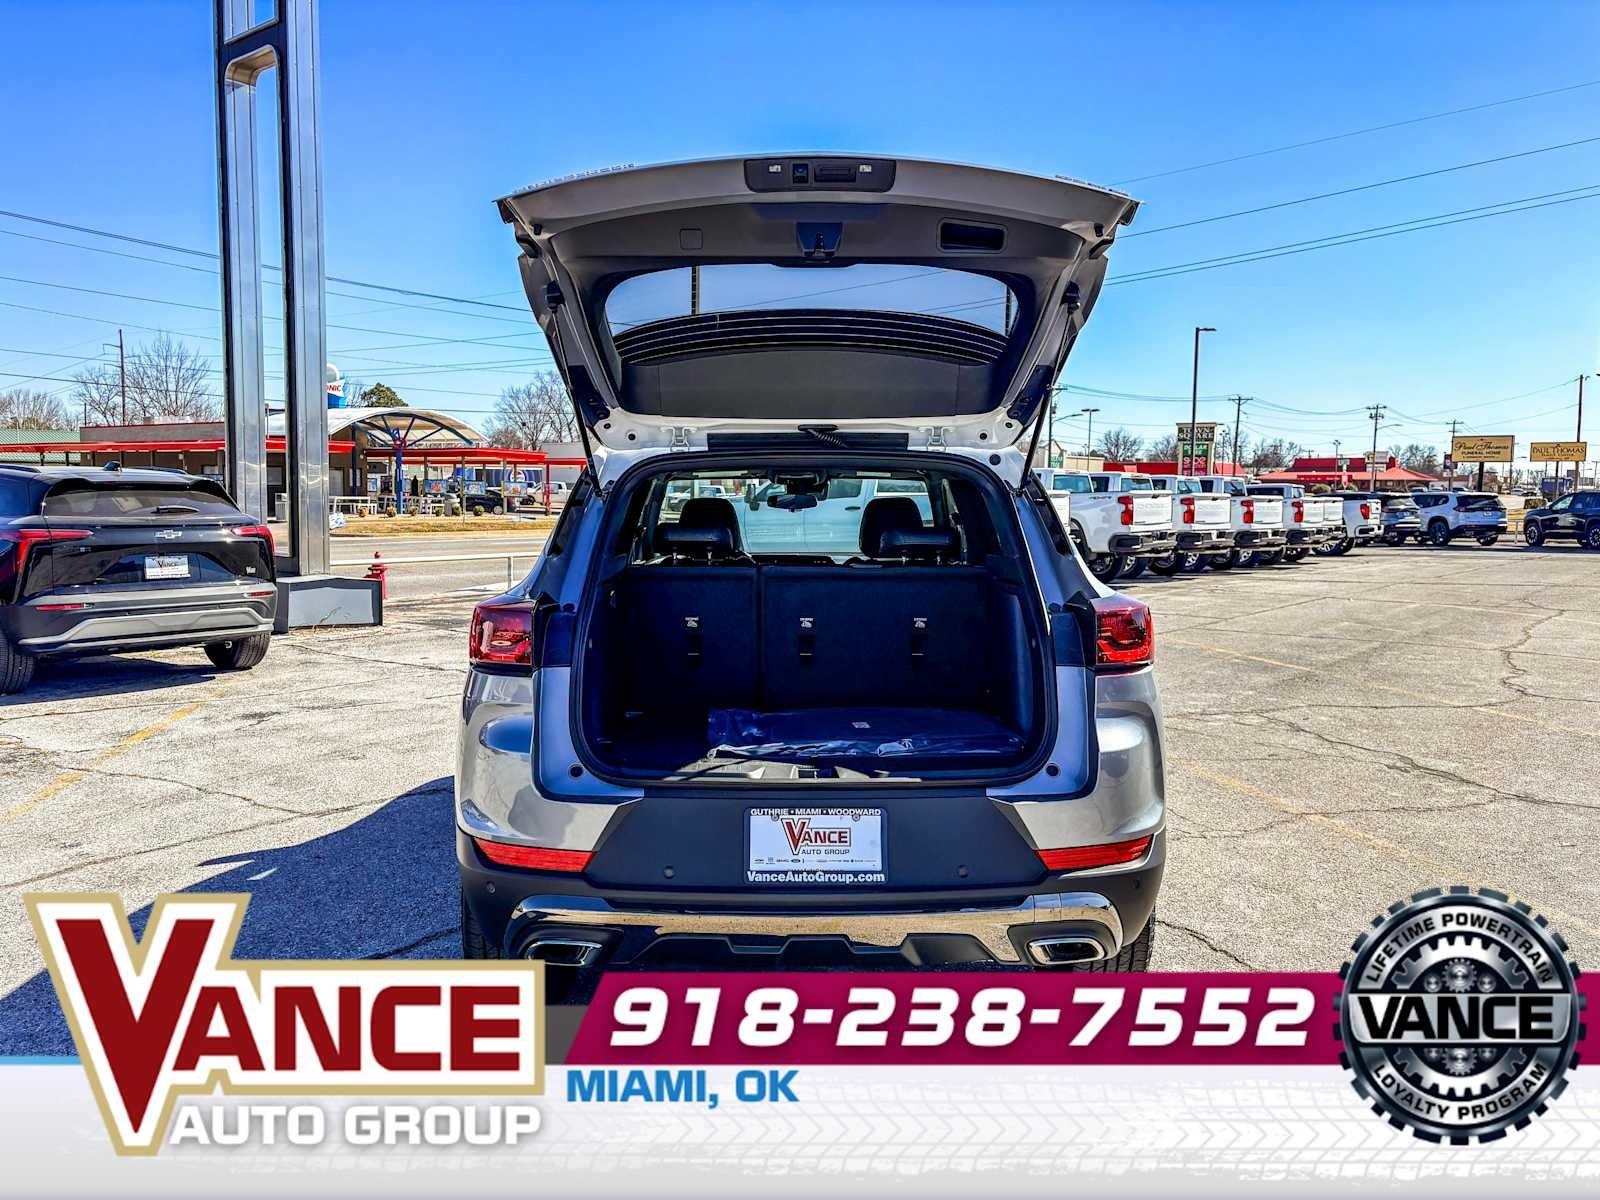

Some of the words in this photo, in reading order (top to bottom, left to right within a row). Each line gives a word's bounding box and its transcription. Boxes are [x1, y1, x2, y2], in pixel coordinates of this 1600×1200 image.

[1454, 441, 1477, 451] Paul
[1552, 446, 1585, 454] THOMAS
[750, 808, 789, 816] GUTHRIE
[795, 808, 822, 816] MIAMI
[827, 808, 882, 816] WOODWARD
[784, 820, 850, 851] VANCE
[747, 870, 886, 884] VanceAutoGroup.com
